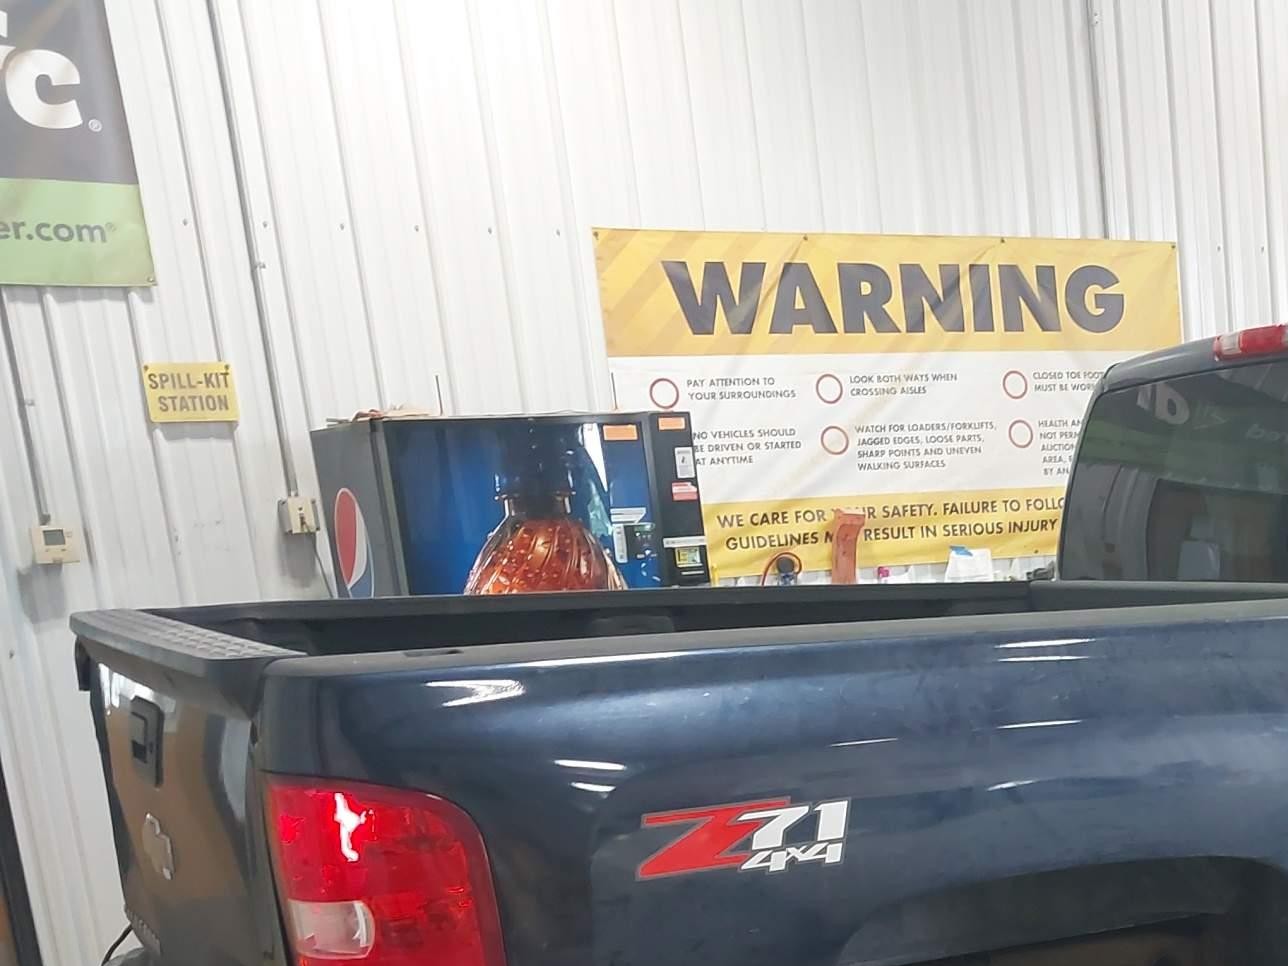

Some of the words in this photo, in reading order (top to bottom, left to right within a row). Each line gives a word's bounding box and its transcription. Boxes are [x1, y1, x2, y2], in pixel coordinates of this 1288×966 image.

[660, 260, 1126, 336] WARNING
[148, 372, 229, 389] SPILL-KIT
[849, 375, 875, 384] LOOK
[877, 374, 901, 383] BOTH
[903, 373, 930, 383] WAYS
[930, 373, 958, 382] WHEN
[1032, 371, 1064, 380] CLOSED
[1065, 371, 1082, 379] TOE
[686, 378, 705, 388] PAY
[709, 376, 761, 387] ATTENTION
[763, 376, 775, 386] TO
[1034, 384, 1057, 392] MUST
[688, 391, 716, 400] YOUR
[719, 390, 797, 400] SURROUNDINGS
[850, 386, 898, 396] CROSSING
[900, 385, 928, 395] AISLES
[158, 395, 229, 412] STATION
[855, 424, 886, 433] WATCH
[889, 424, 905, 433] FOR
[1038, 419, 1068, 428] HEALTH
[692, 431, 708, 440] NO
[711, 430, 755, 439] VEHICLES
[757, 428, 796, 438] SHOULD
[1040, 432, 1056, 440] NOT
[708, 443, 743, 453] DRIVEN
[747, 441, 761, 451] OR
[765, 440, 802, 450] STARTED
[857, 437, 890, 447] JAGGED
[926, 435, 953, 444] LOOSE
[857, 450, 885, 459] SHARP
[888, 448, 921, 458] POINTS
[924, 447, 944, 456] AND
[946, 446, 982, 456] UNEVEN
[709, 456, 754, 465] ANYTIME
[857, 461, 901, 471] WALKING
[903, 460, 946, 470] SURFACES
[881, 503, 938, 519] SAFETY.
[943, 500, 998, 516] FAILURE
[1002, 499, 1021, 513] TO
[716, 514, 744, 529] WE
[750, 511, 789, 527] CARE
[795, 509, 826, 524] FOR
[864, 526, 917, 541] RESULT
[921, 525, 937, 538] IN
[943, 522, 1003, 537] SERIOUS
[1008, 518, 1058, 533] INJURY
[725, 531, 819, 551] GUIDELINES
[638, 797, 849, 879] Z71
